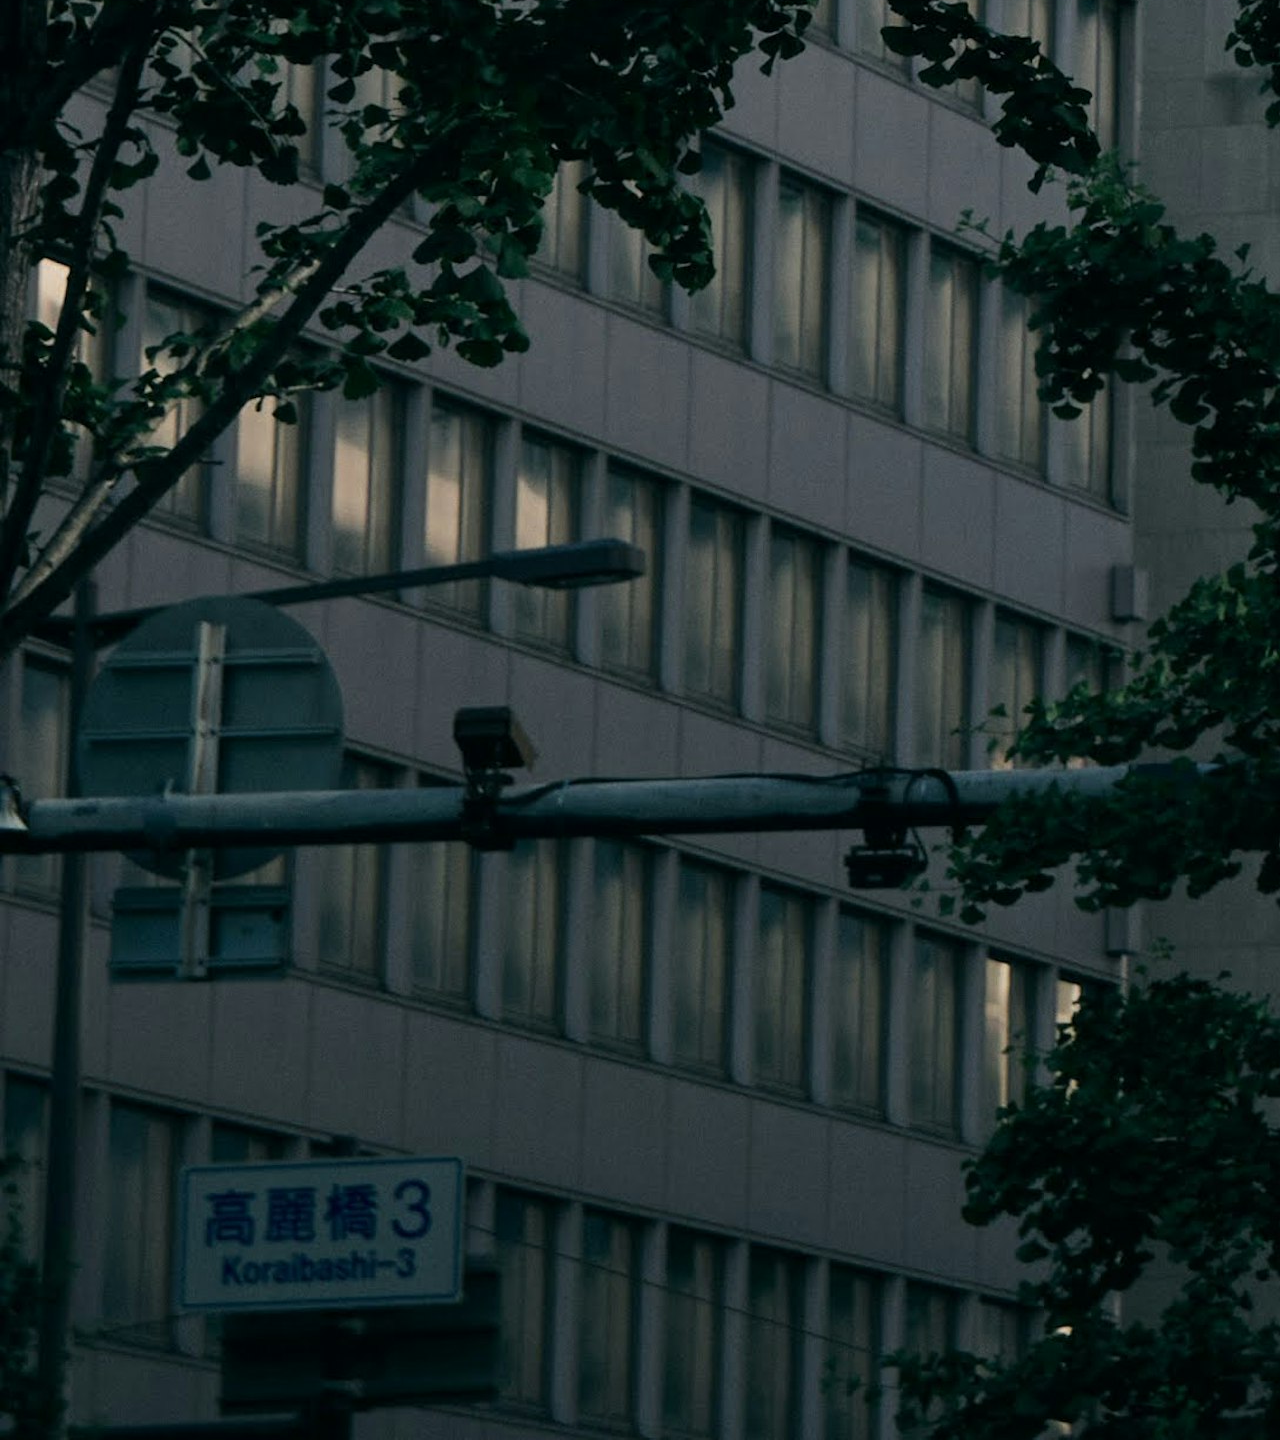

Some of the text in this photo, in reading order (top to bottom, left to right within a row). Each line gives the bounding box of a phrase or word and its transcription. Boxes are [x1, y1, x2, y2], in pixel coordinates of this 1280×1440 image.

[205, 1178, 432, 1248] 高麗橋3
[222, 1248, 417, 1285] Koraibashi-3
